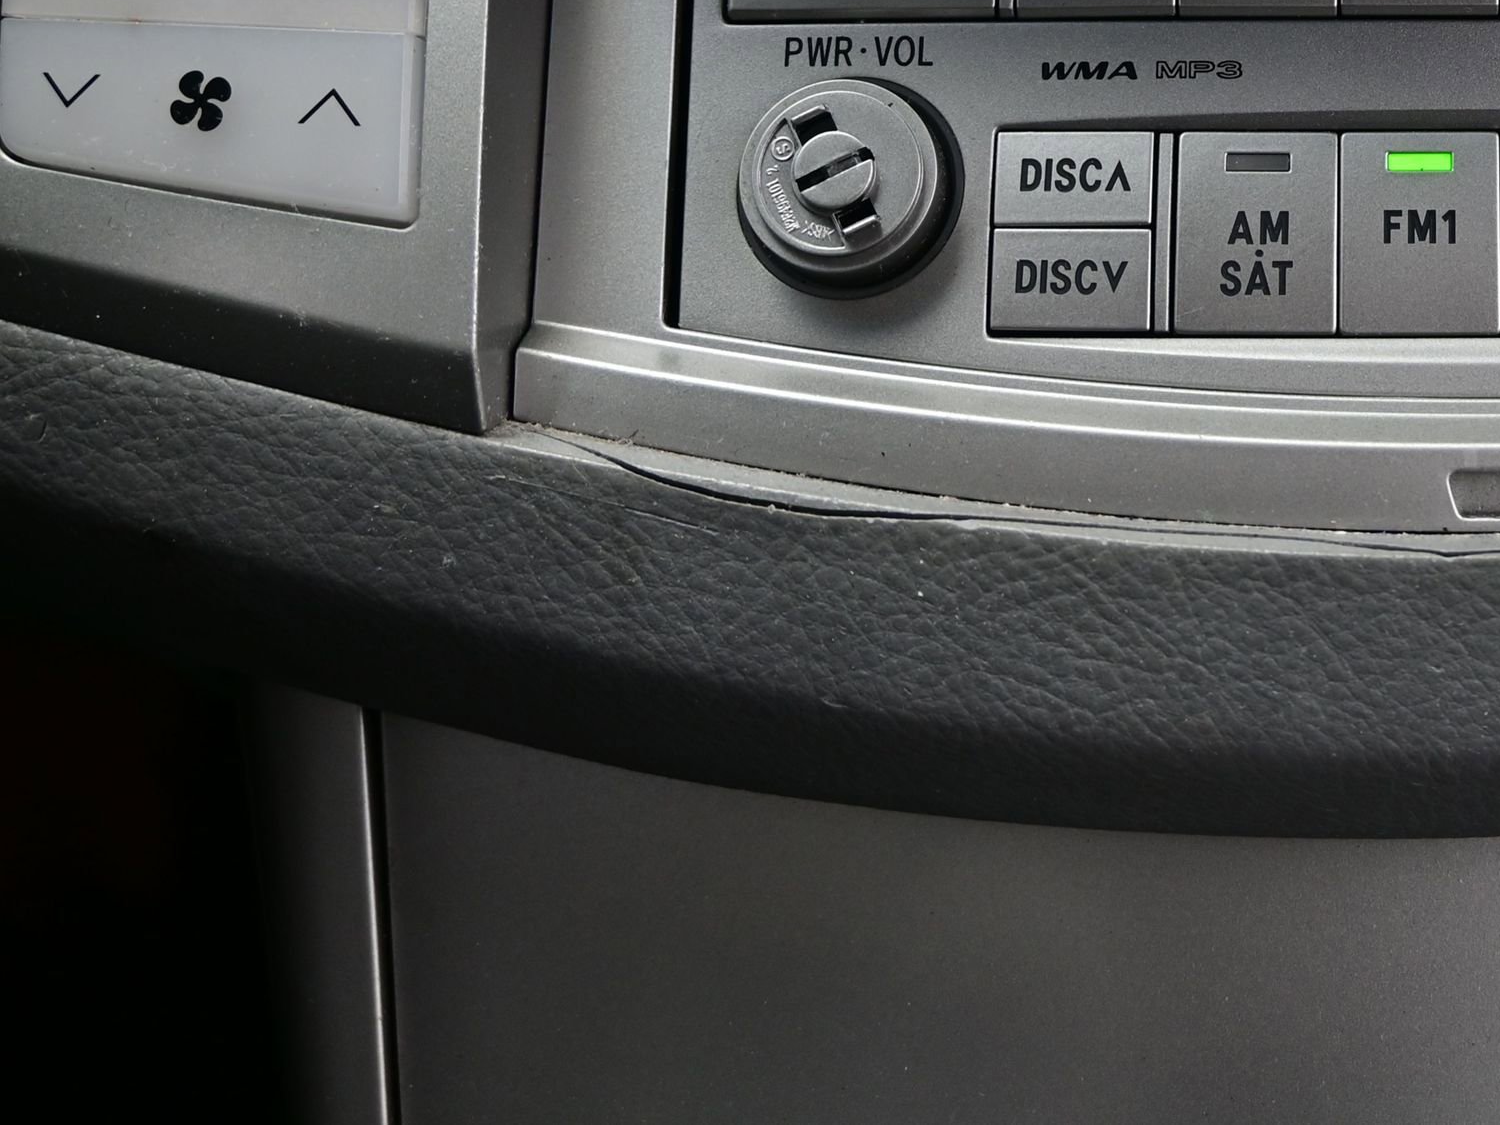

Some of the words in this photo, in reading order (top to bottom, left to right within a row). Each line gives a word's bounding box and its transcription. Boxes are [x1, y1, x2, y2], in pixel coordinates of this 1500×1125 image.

[1042, 61, 1137, 80] WMA
[1156, 60, 1242, 79] MP3
[1228, 211, 1289, 245] AM
[1384, 210, 1455, 244] FM1
[1219, 261, 1293, 296] SAT
